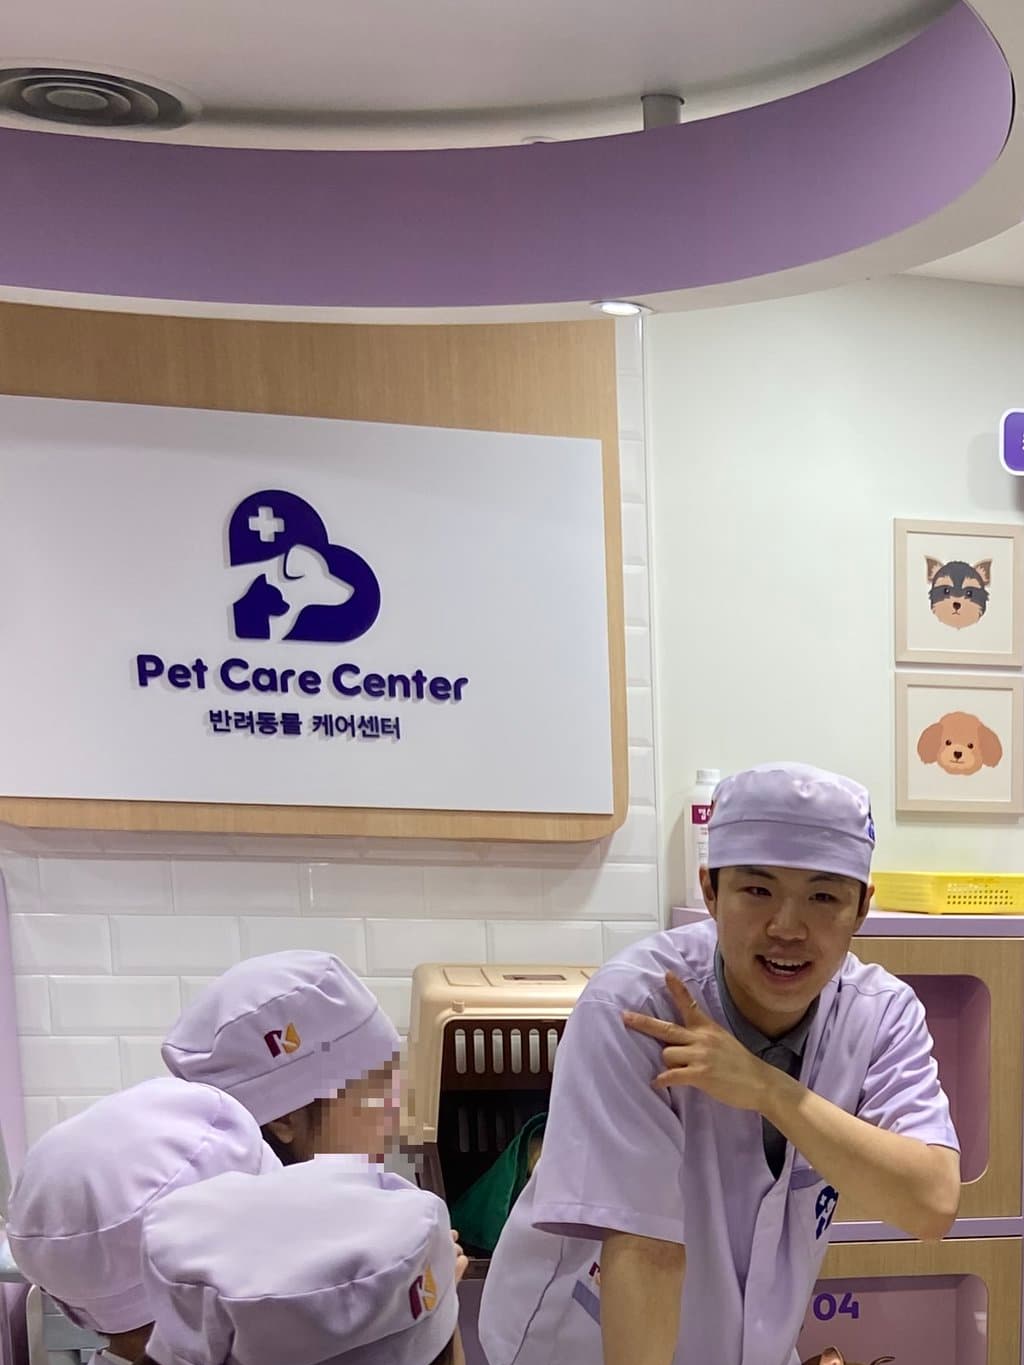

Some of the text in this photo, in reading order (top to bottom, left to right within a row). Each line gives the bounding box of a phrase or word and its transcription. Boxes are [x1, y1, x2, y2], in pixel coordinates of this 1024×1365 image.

[136, 654, 469, 701] Pet Care Center
[209, 709, 401, 740] 반려동물 케어센터
[812, 1292, 860, 1320] 04
